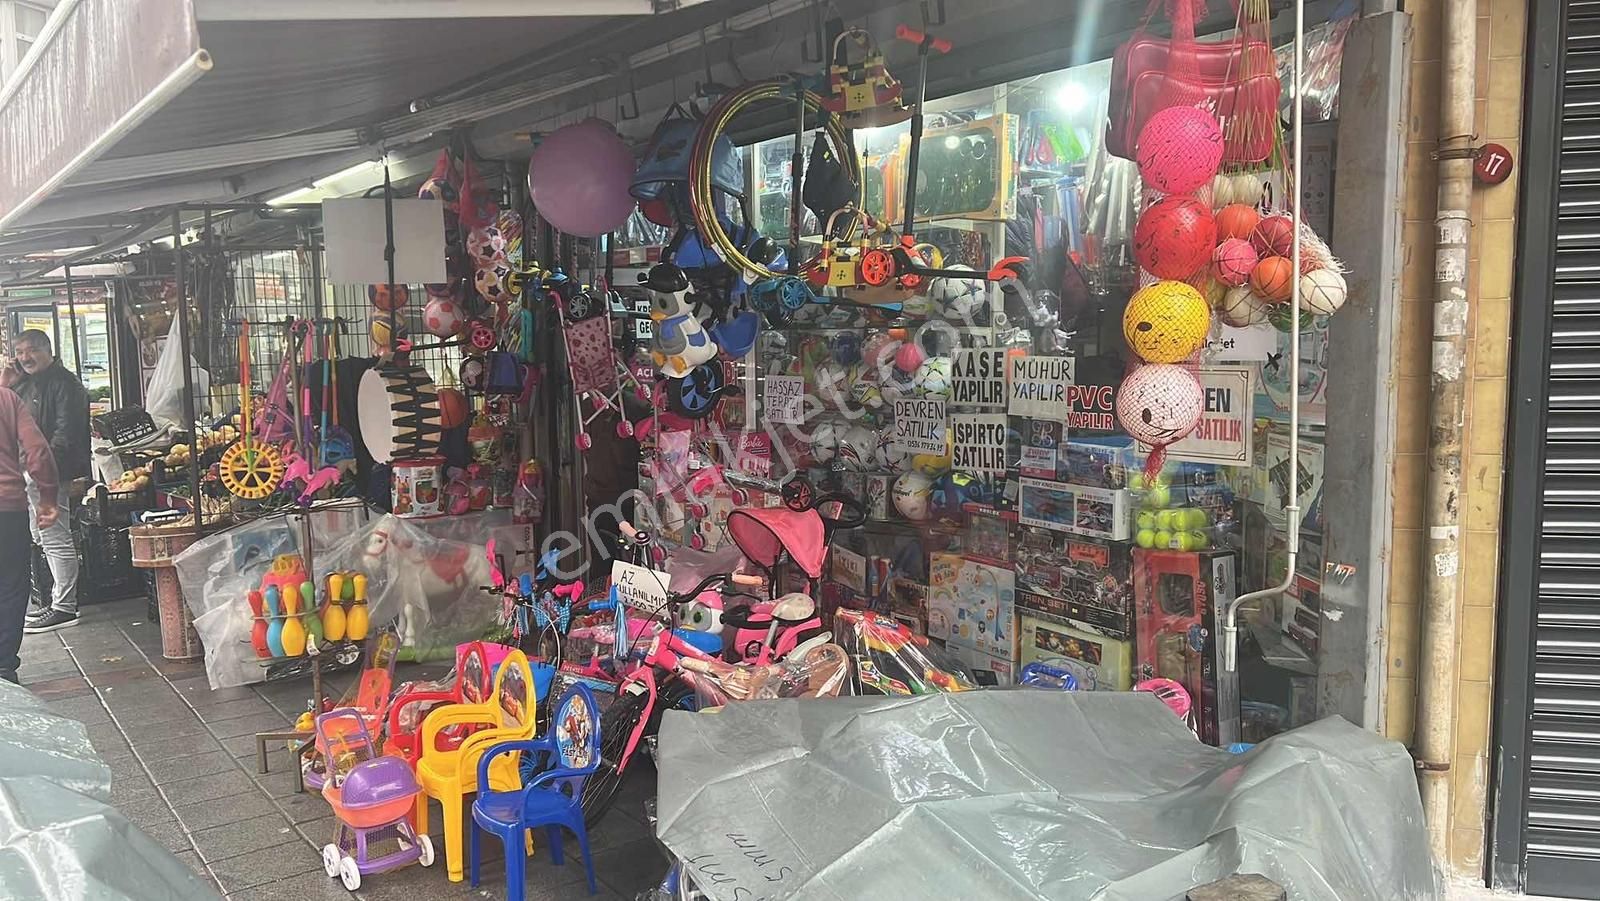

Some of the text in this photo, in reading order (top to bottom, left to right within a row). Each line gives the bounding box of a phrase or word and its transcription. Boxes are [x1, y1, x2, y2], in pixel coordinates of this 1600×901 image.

[1485, 153, 1504, 175] 17
[952, 351, 1004, 379] KAŞE
[1014, 358, 1072, 381] MÜHÜR
[768, 380, 802, 396] HASSAZ
[952, 378, 1003, 404] YAPILIR
[1013, 382, 1064, 402] YAPILIR
[1066, 386, 1113, 411] PVC
[895, 400, 945, 420] DEVREN
[897, 419, 940, 440] SATILIK
[1067, 412, 1114, 431] YAPILIR
[1196, 417, 1241, 442] SATILIK
[741, 435, 764, 449] Barbie
[953, 419, 1005, 446] İSPİRTO
[953, 450, 1005, 470] SATILIR
[620, 569, 635, 585] AZ
